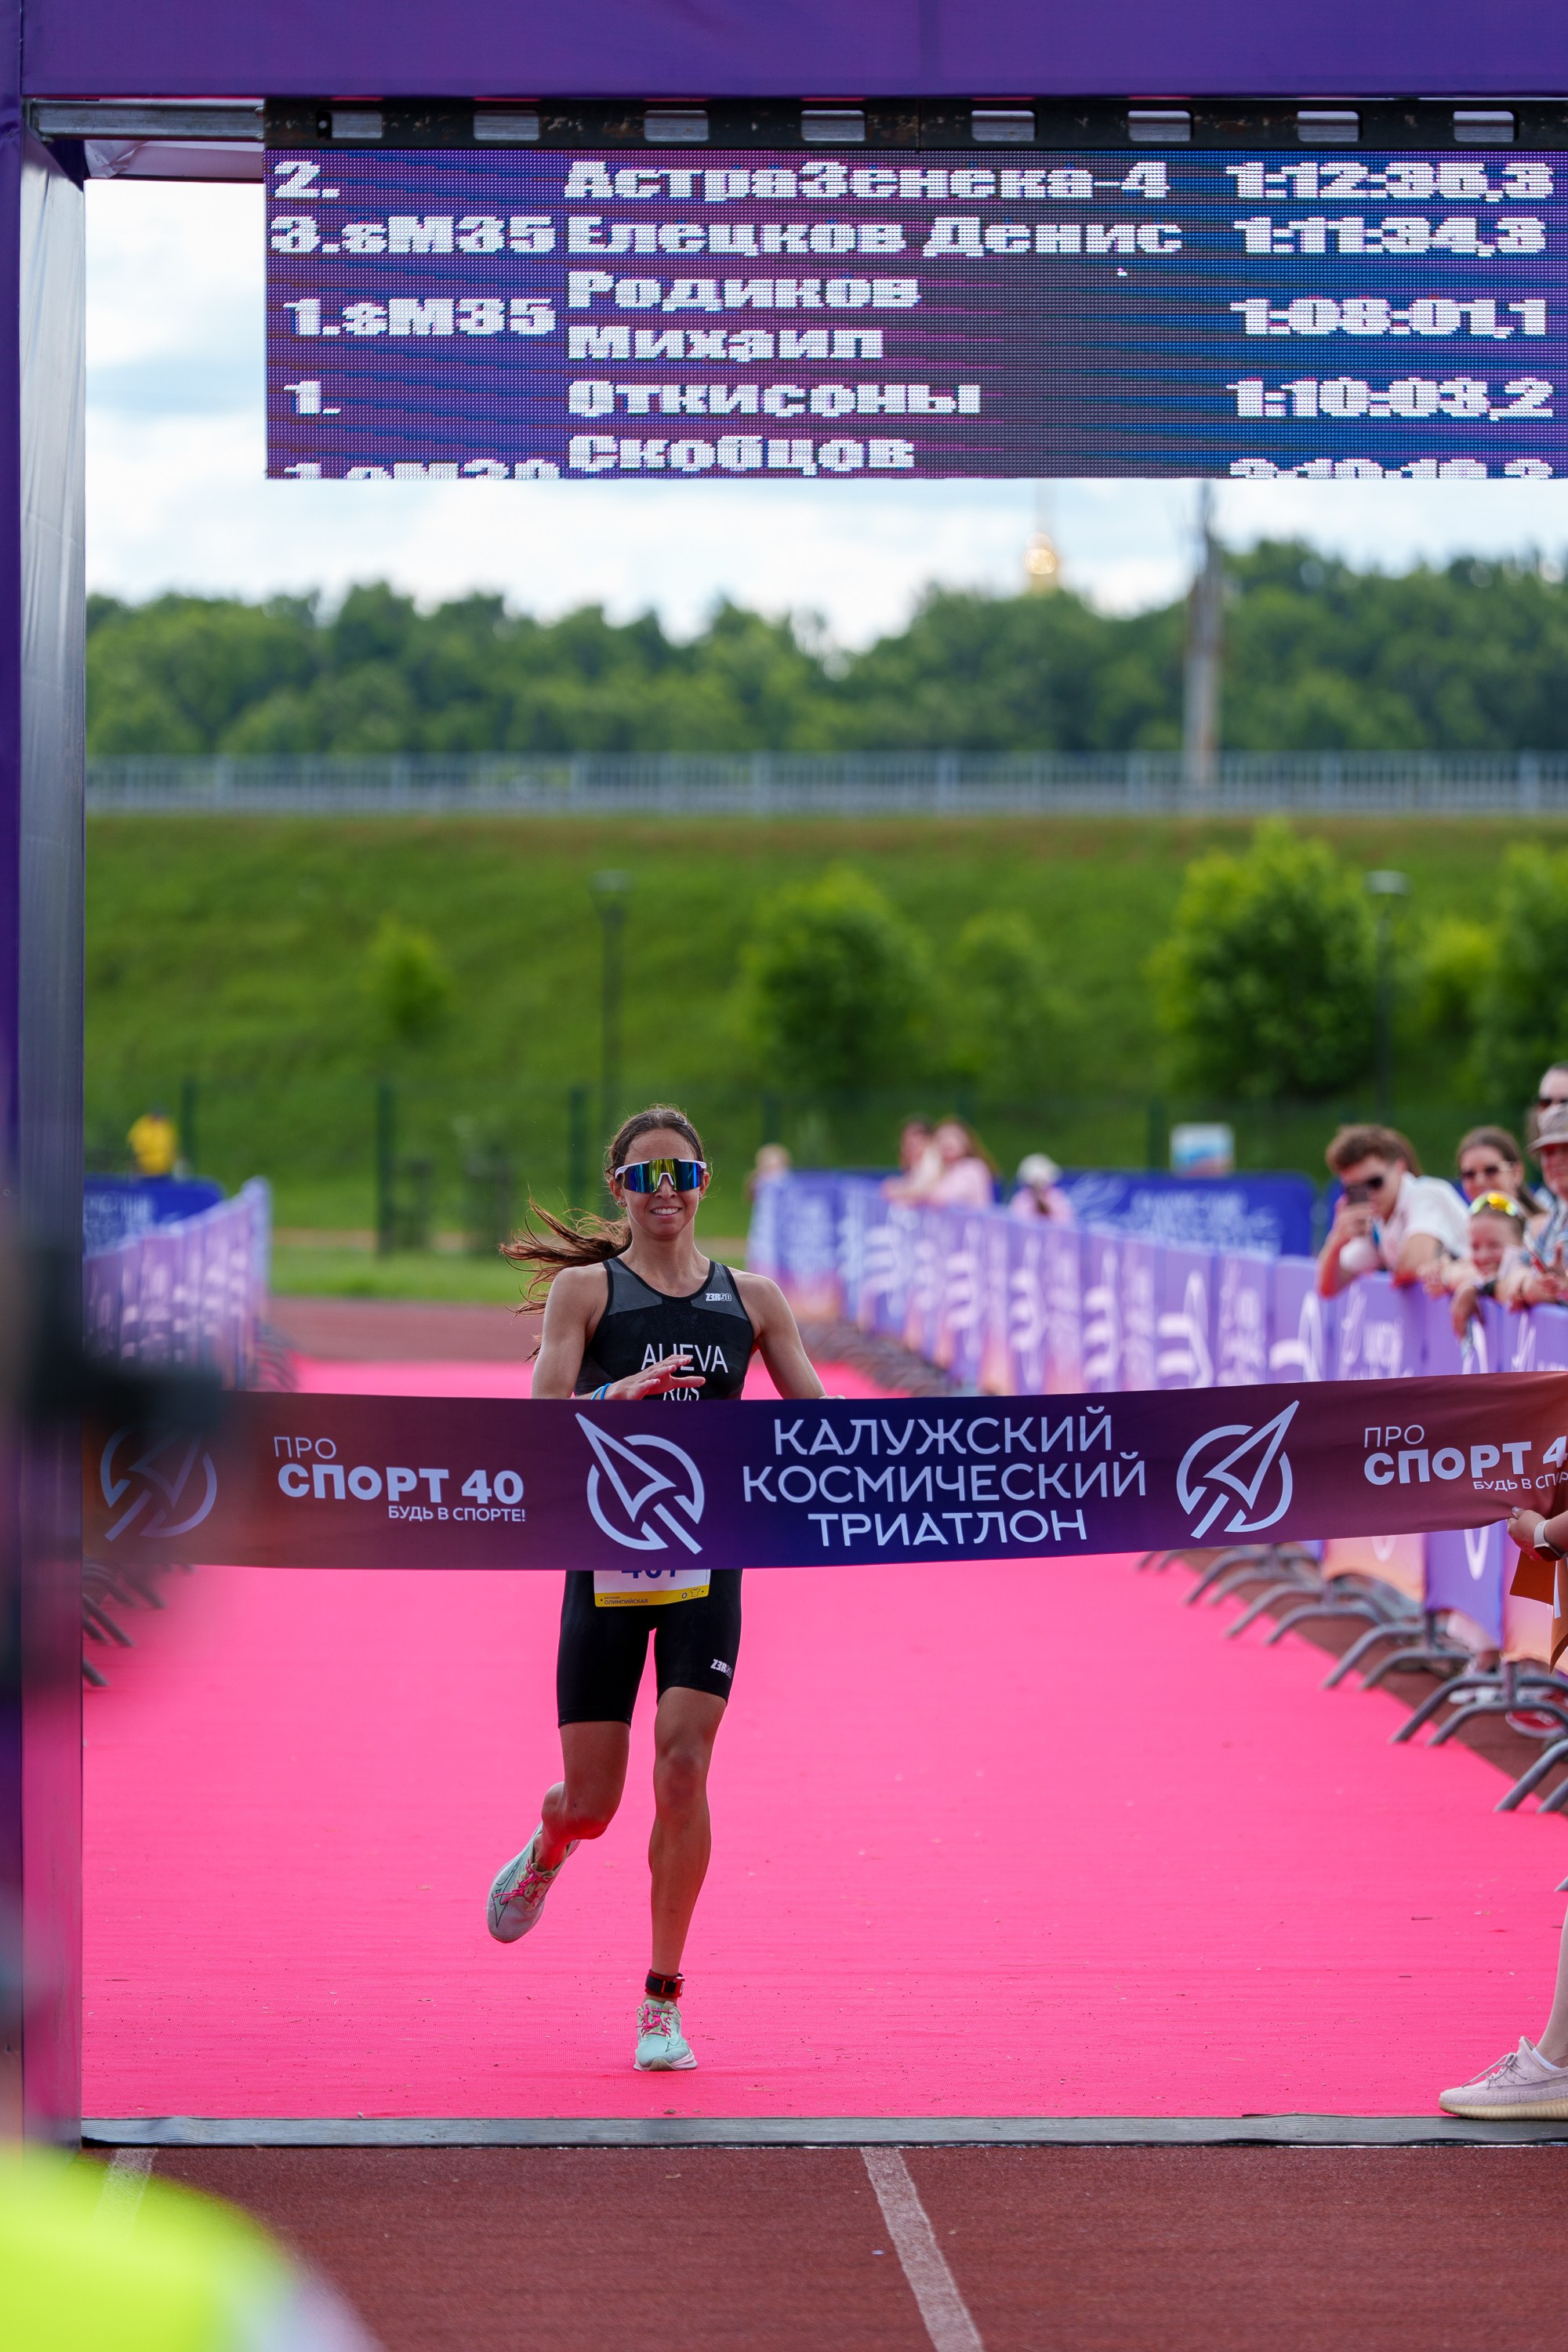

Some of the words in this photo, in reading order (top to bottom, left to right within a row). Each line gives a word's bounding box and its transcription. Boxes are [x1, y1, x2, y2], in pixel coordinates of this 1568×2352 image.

[274, 162, 339, 197] 2.
[568, 216, 906, 256] Елецков
[923, 217, 1182, 256] Денис
[568, 271, 921, 311] Родиков
[568, 326, 884, 361] Михаил
[284, 381, 340, 413] 1.
[568, 381, 981, 417] Откисоны
[568, 435, 915, 475] Скобцов
[274, 1436, 337, 1460] ПРО
[774, 1406, 1112, 1456] КАЛУЖСКИЙ
[1363, 1425, 1425, 1448] ПРО
[742, 1451, 1146, 1503] КОСМИЧЕСКИЙ
[1363, 1441, 1532, 1485] СПОРТ
[278, 1463, 449, 1503] СПОРТ
[461, 1469, 524, 1504] 40
[1472, 1479, 1518, 1492] БУДЬ
[1521, 1478, 1532, 1490] В
[388, 1505, 434, 1522] БУДЬ
[437, 1507, 449, 1520] В
[452, 1508, 526, 1523] СПОРТЕ!
[808, 1509, 1087, 1547] ТРИАТЛОН
